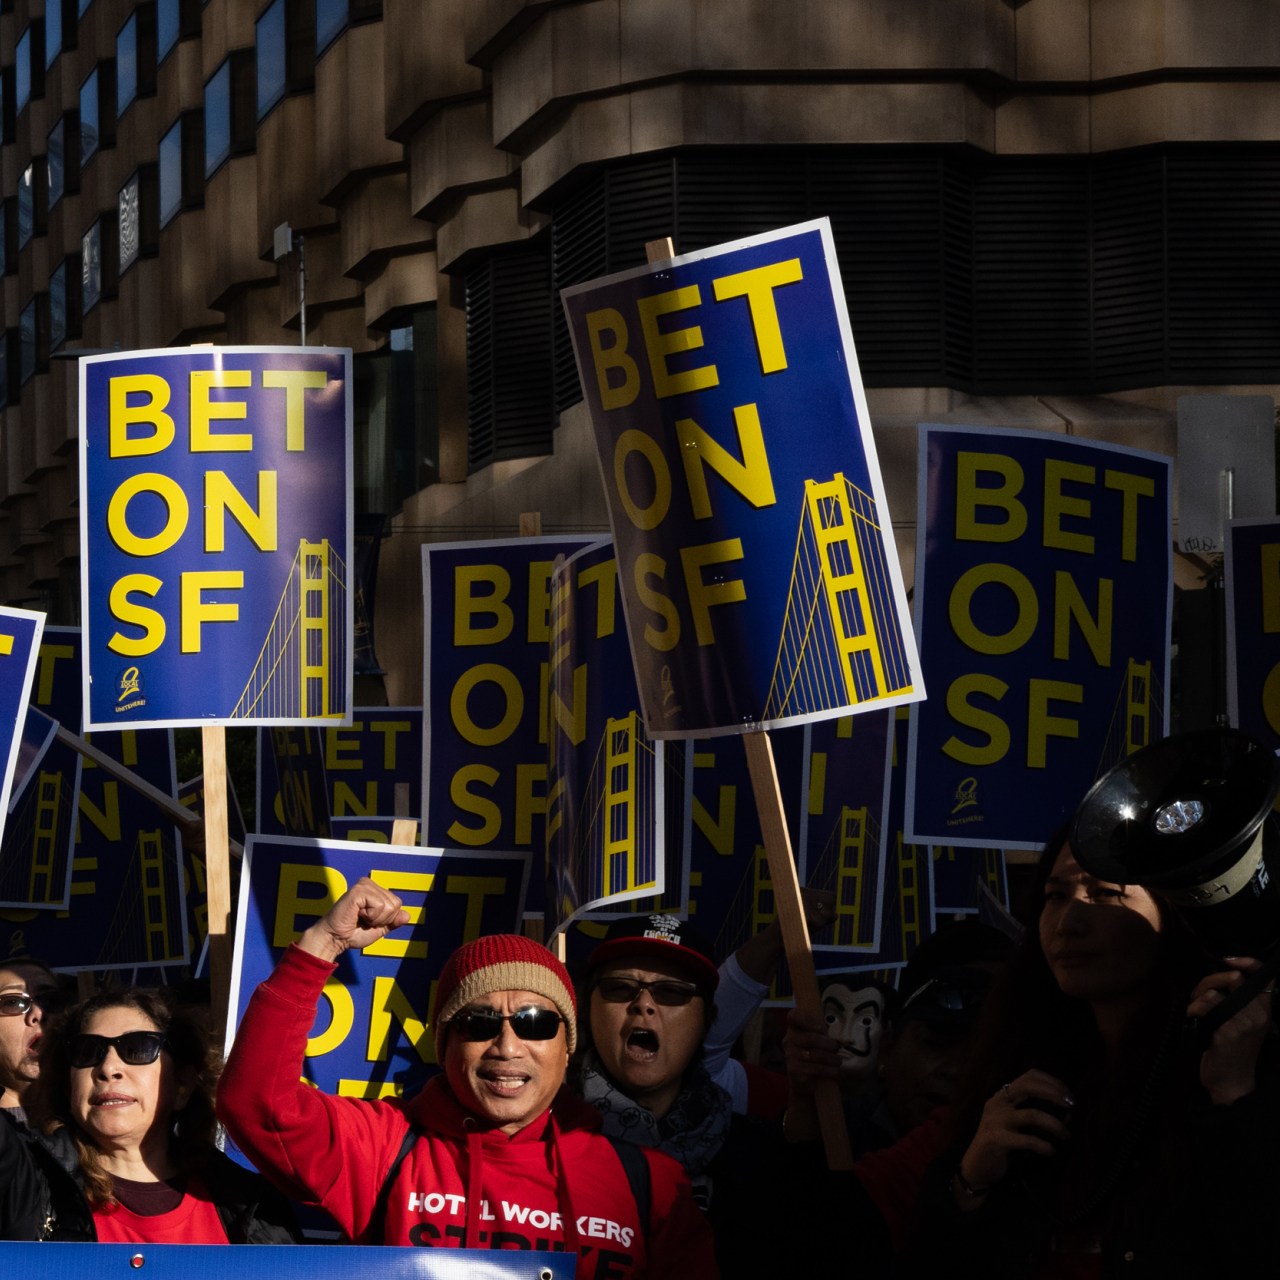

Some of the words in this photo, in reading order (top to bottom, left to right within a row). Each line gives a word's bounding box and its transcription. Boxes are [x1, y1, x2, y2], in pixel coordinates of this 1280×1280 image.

[587, 258, 803, 410] BET
[109, 370, 328, 458] BET
[107, 470, 278, 558] ON
[615, 403, 777, 531] ON
[956, 452, 1155, 561] BET
[108, 571, 244, 657] SF
[634, 538, 747, 651] SF
[949, 564, 1113, 667] ON
[114, 698, 146, 713] UNITEHERE!
[325, 721, 412, 770] ET
[943, 674, 1083, 769] SF
